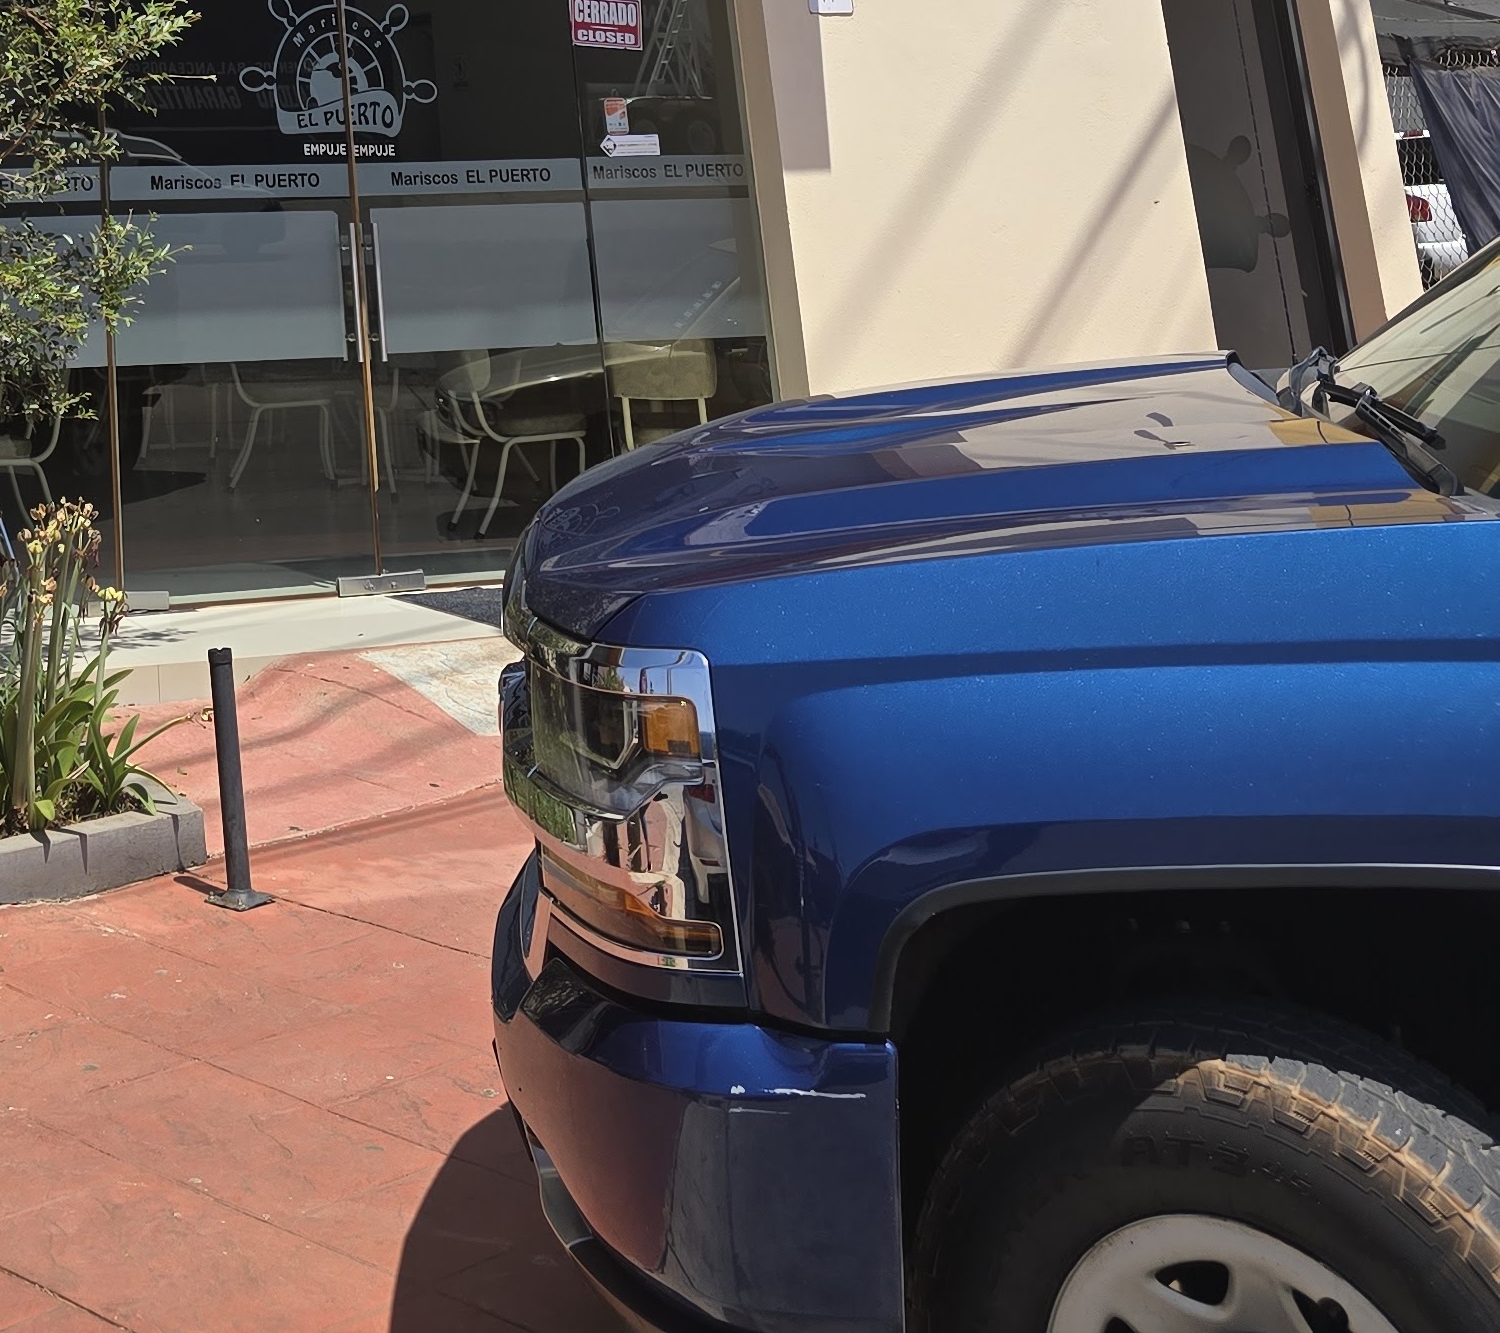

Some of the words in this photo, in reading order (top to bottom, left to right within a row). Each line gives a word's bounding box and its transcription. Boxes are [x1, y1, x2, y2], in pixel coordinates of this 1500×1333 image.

[292, 14, 382, 49] Maricos
[577, 29, 636, 46] CLOSED
[297, 113, 319, 129] EL
[303, 143, 347, 156] EMPUJE
[352, 144, 396, 157] EMPUJE
[390, 170, 458, 187] Mariscos
[466, 169, 486, 185] EL
[489, 166, 552, 184] PUERTO
[593, 164, 657, 181] Mariscos
[664, 163, 682, 179] EL
[685, 161, 744, 179] PUERTO
[150, 173, 222, 191] Mariscos
[230, 174, 246, 190] EL
[254, 171, 321, 190] PUERTO
